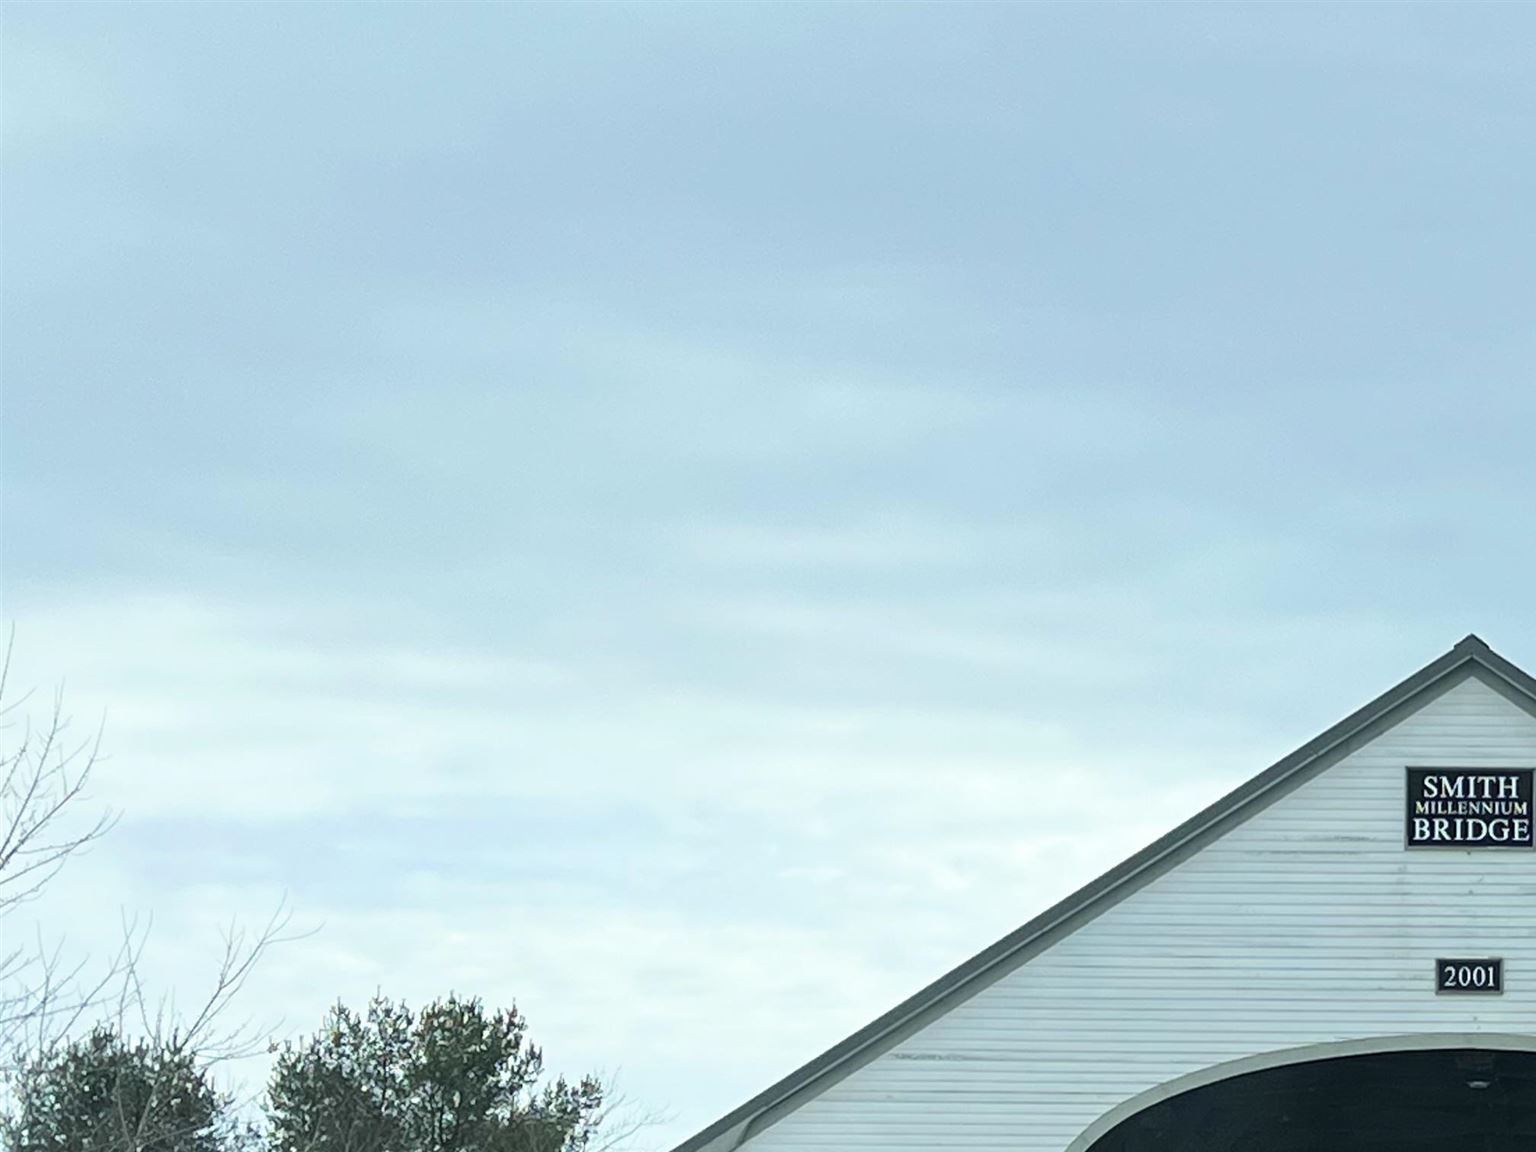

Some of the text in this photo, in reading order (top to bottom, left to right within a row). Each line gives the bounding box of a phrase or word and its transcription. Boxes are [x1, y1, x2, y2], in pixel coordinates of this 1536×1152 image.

[1423, 775, 1520, 799] SMITH
[1415, 801, 1528, 815] MILLENNIUM
[1412, 817, 1530, 841] BRIDGE
[1443, 965, 1495, 987] 2001
